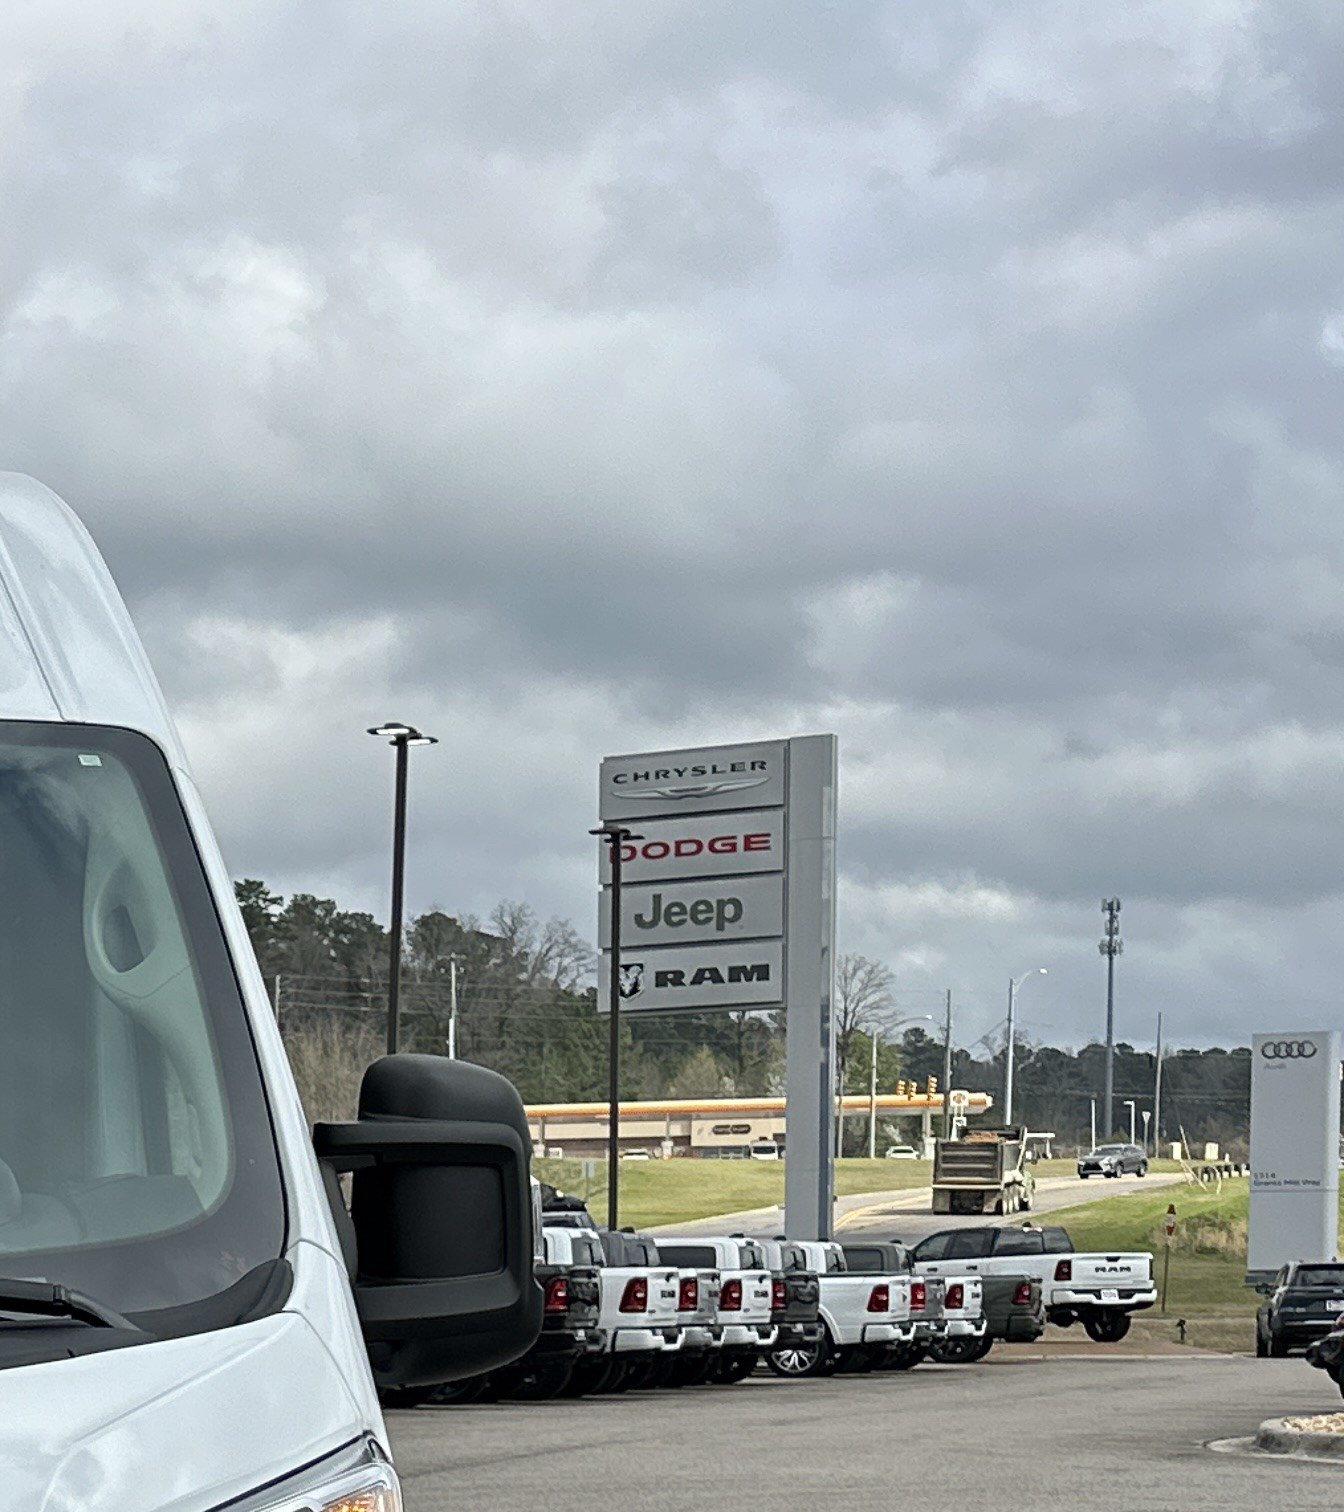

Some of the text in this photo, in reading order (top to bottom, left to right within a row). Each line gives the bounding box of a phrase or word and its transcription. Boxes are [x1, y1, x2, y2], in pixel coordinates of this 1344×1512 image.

[613, 760, 767, 785] CHRYSLER
[609, 832, 771, 864] DODGE
[634, 893, 743, 932] Jeep
[655, 964, 770, 988] RAM
